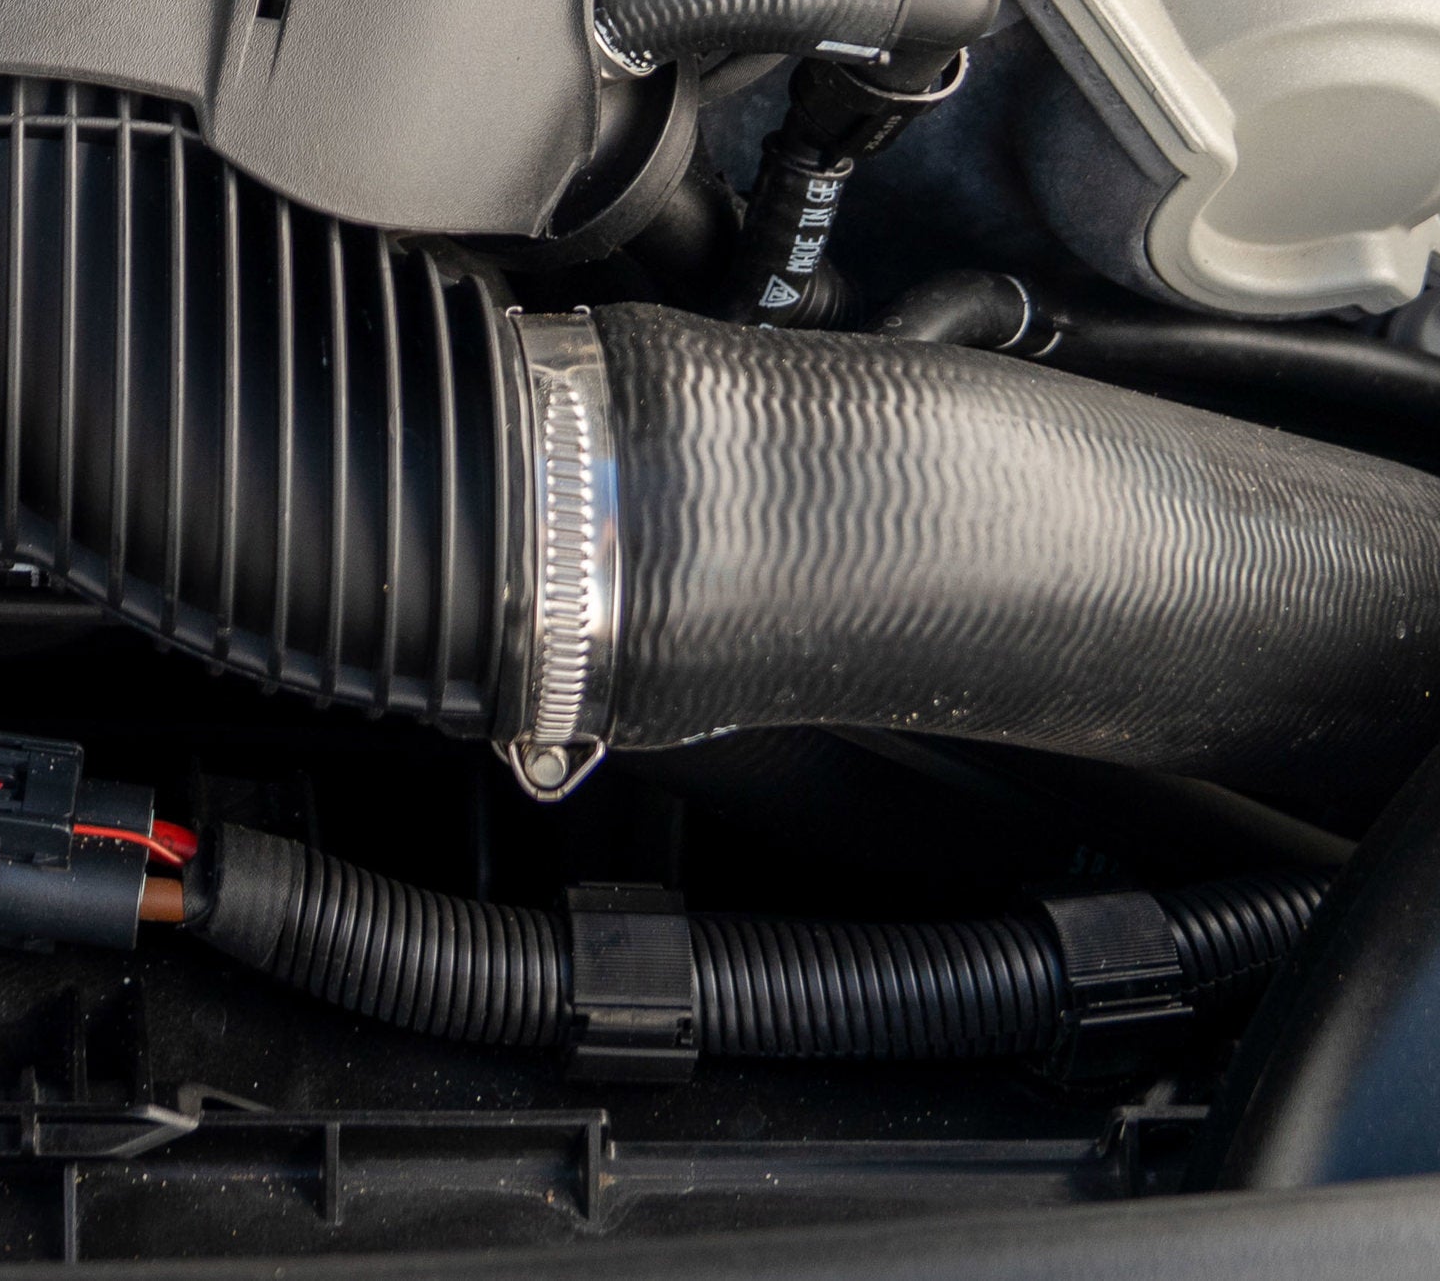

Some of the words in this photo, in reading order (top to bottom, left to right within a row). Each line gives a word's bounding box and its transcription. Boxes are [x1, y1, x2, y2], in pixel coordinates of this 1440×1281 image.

[806, 178, 838, 203] GE
[798, 206, 835, 228] IN
[786, 234, 824, 274] MADE
